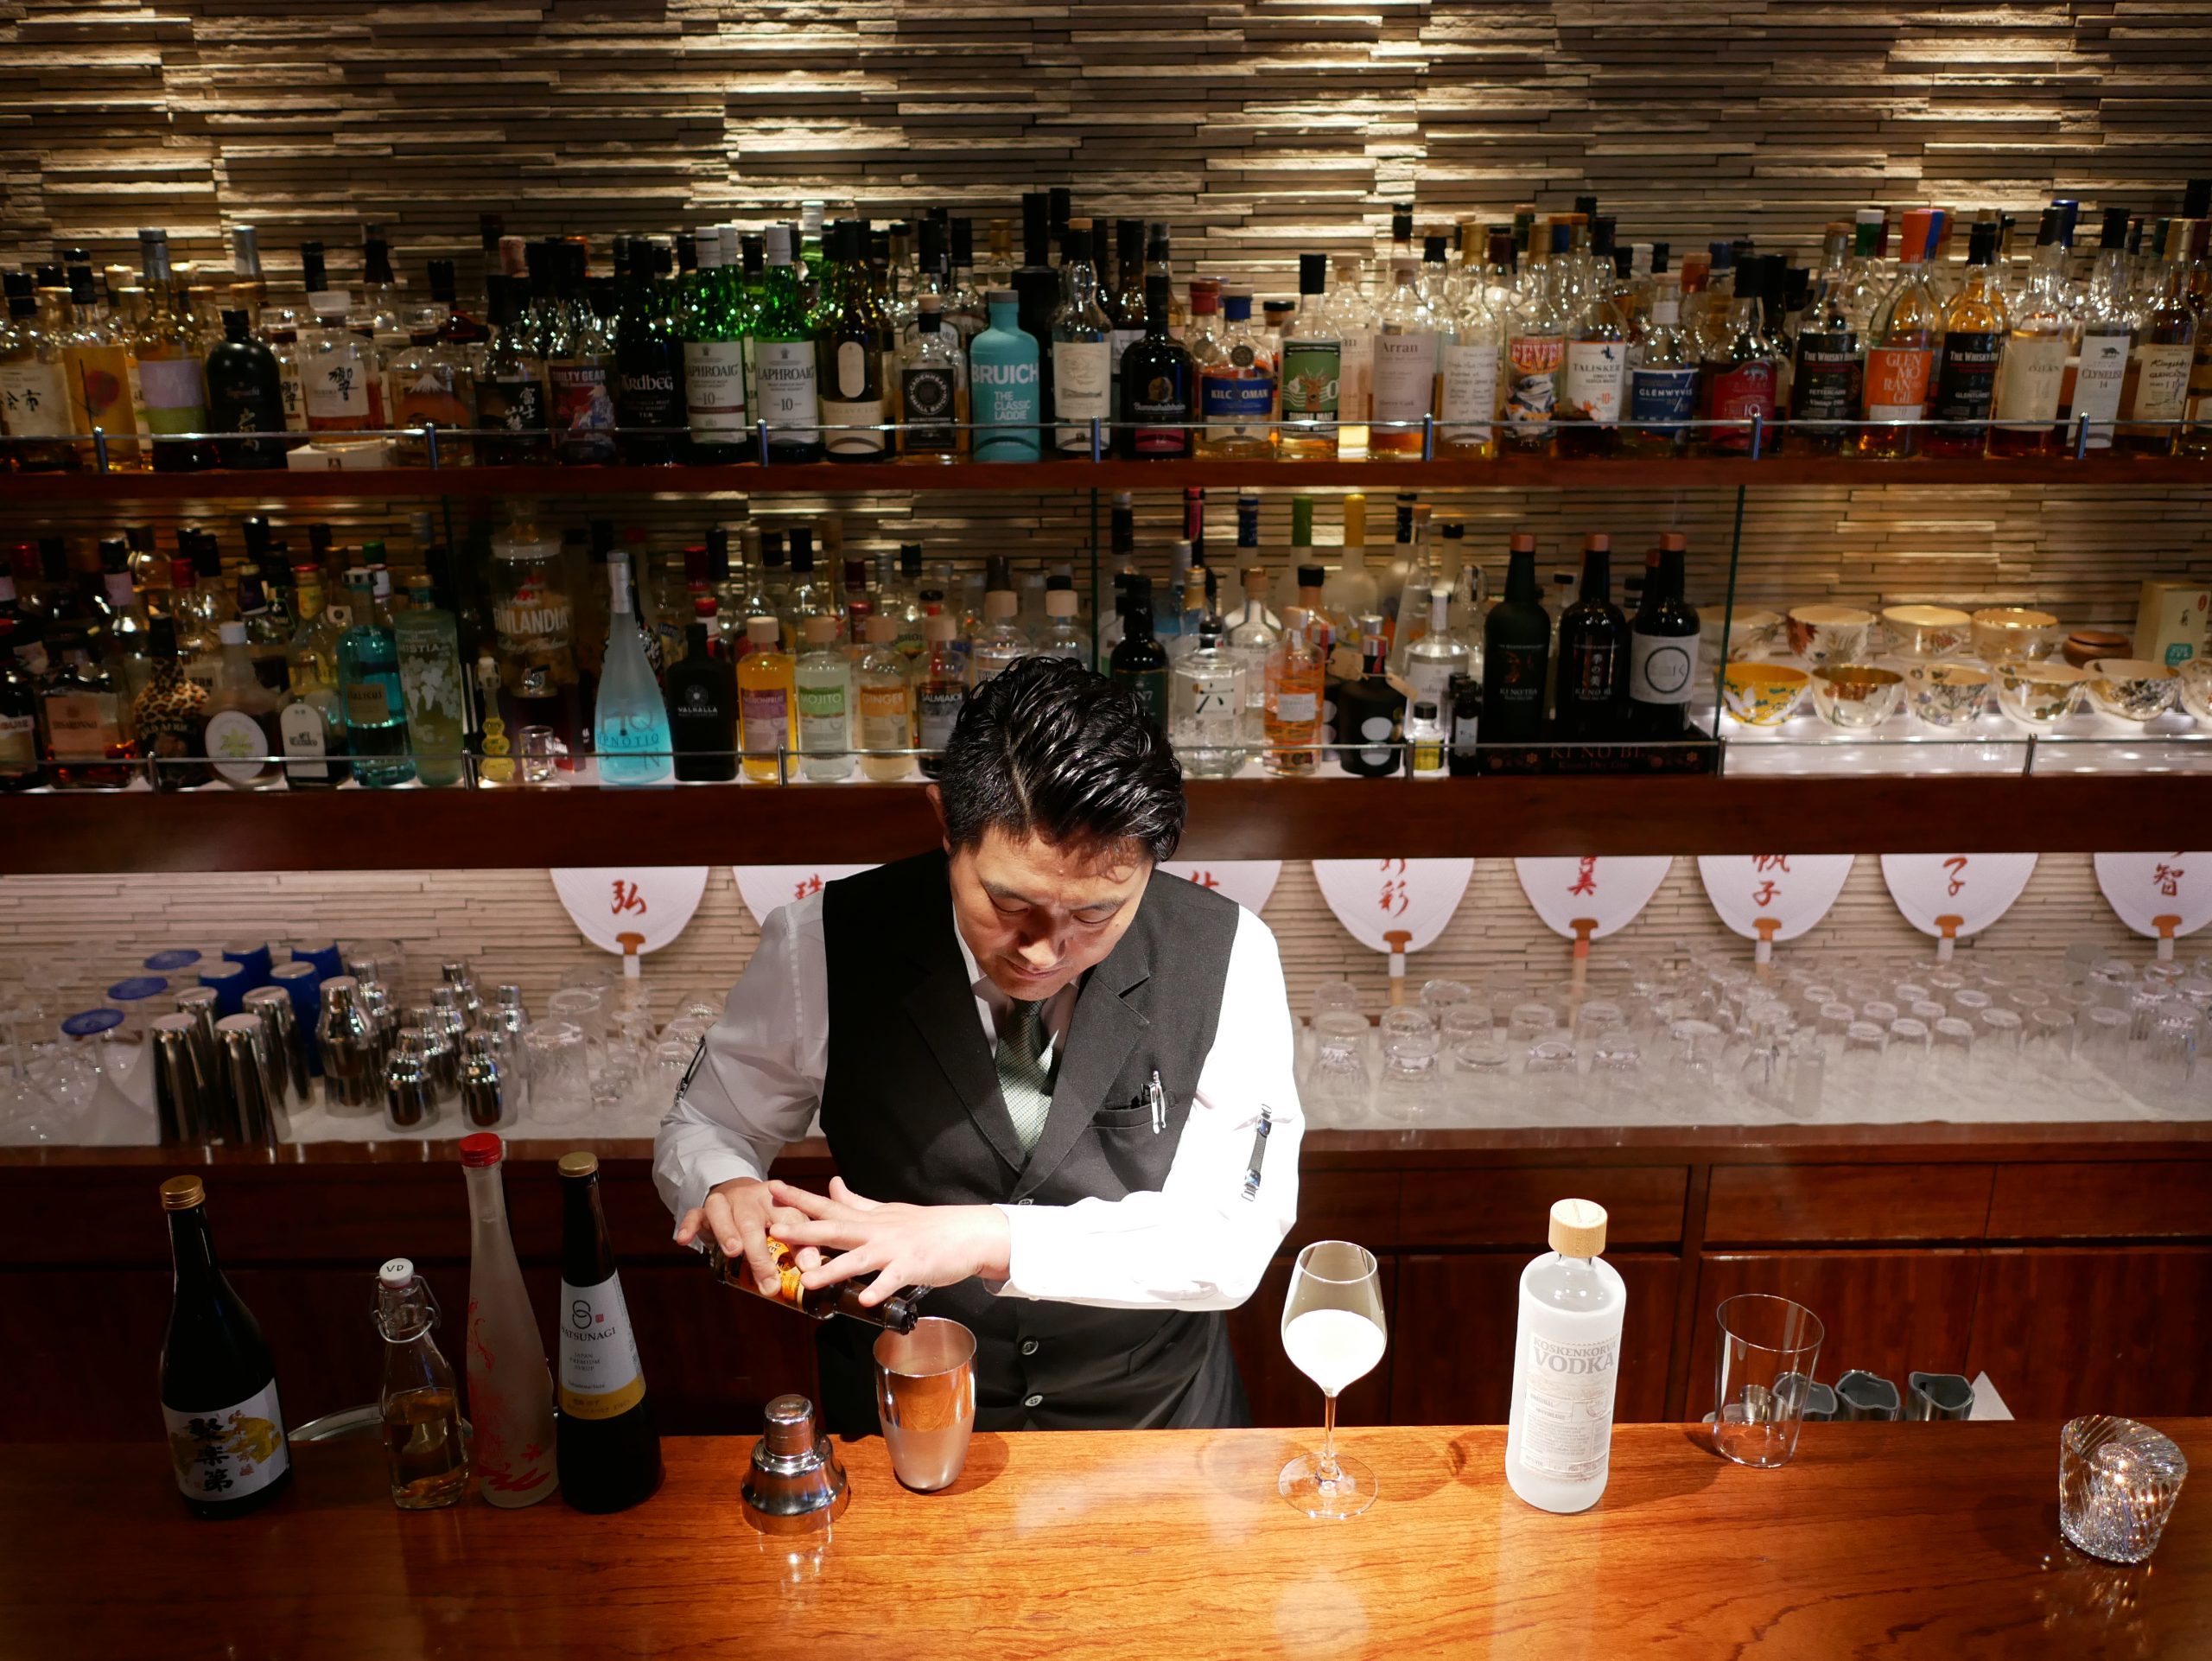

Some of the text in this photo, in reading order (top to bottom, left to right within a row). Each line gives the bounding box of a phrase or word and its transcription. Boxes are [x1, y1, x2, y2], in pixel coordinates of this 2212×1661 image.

[1886, 352, 1922, 366] GLEN
[757, 365, 815, 380] LAPHROAIG
[972, 363, 1039, 385] BRUICH
[1573, 364, 1621, 372] TALISKER
[1897, 366, 1920, 379] MO
[582, 369, 606, 381] GEAR
[1884, 378, 1911, 391] RAN
[994, 391, 1014, 401] THE
[1638, 387, 1693, 396] GLENWYVIS
[702, 391, 715, 405] 10
[781, 398, 793, 411] 10
[994, 400, 1031, 411] CLASSIC
[994, 410, 1027, 421] LADDIE
[801, 694, 842, 704] MOJITO
[862, 693, 904, 704] GINGER
[1535, 1351, 1614, 1374] VODKA
